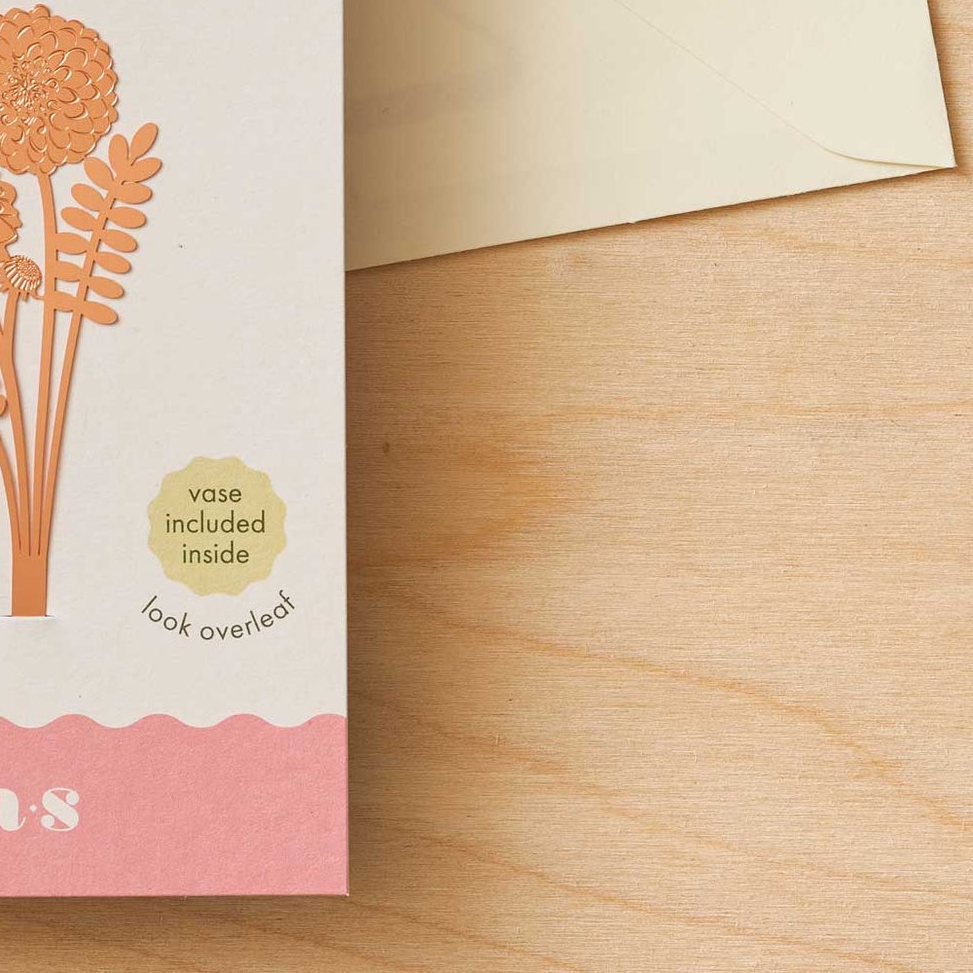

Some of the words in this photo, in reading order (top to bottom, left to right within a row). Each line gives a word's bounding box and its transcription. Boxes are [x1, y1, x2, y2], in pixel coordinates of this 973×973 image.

[188, 488, 243, 504] vase
[165, 509, 266, 534] included
[182, 540, 250, 564] inside
[141, 594, 192, 638] look
[200, 589, 295, 641] overleaf
